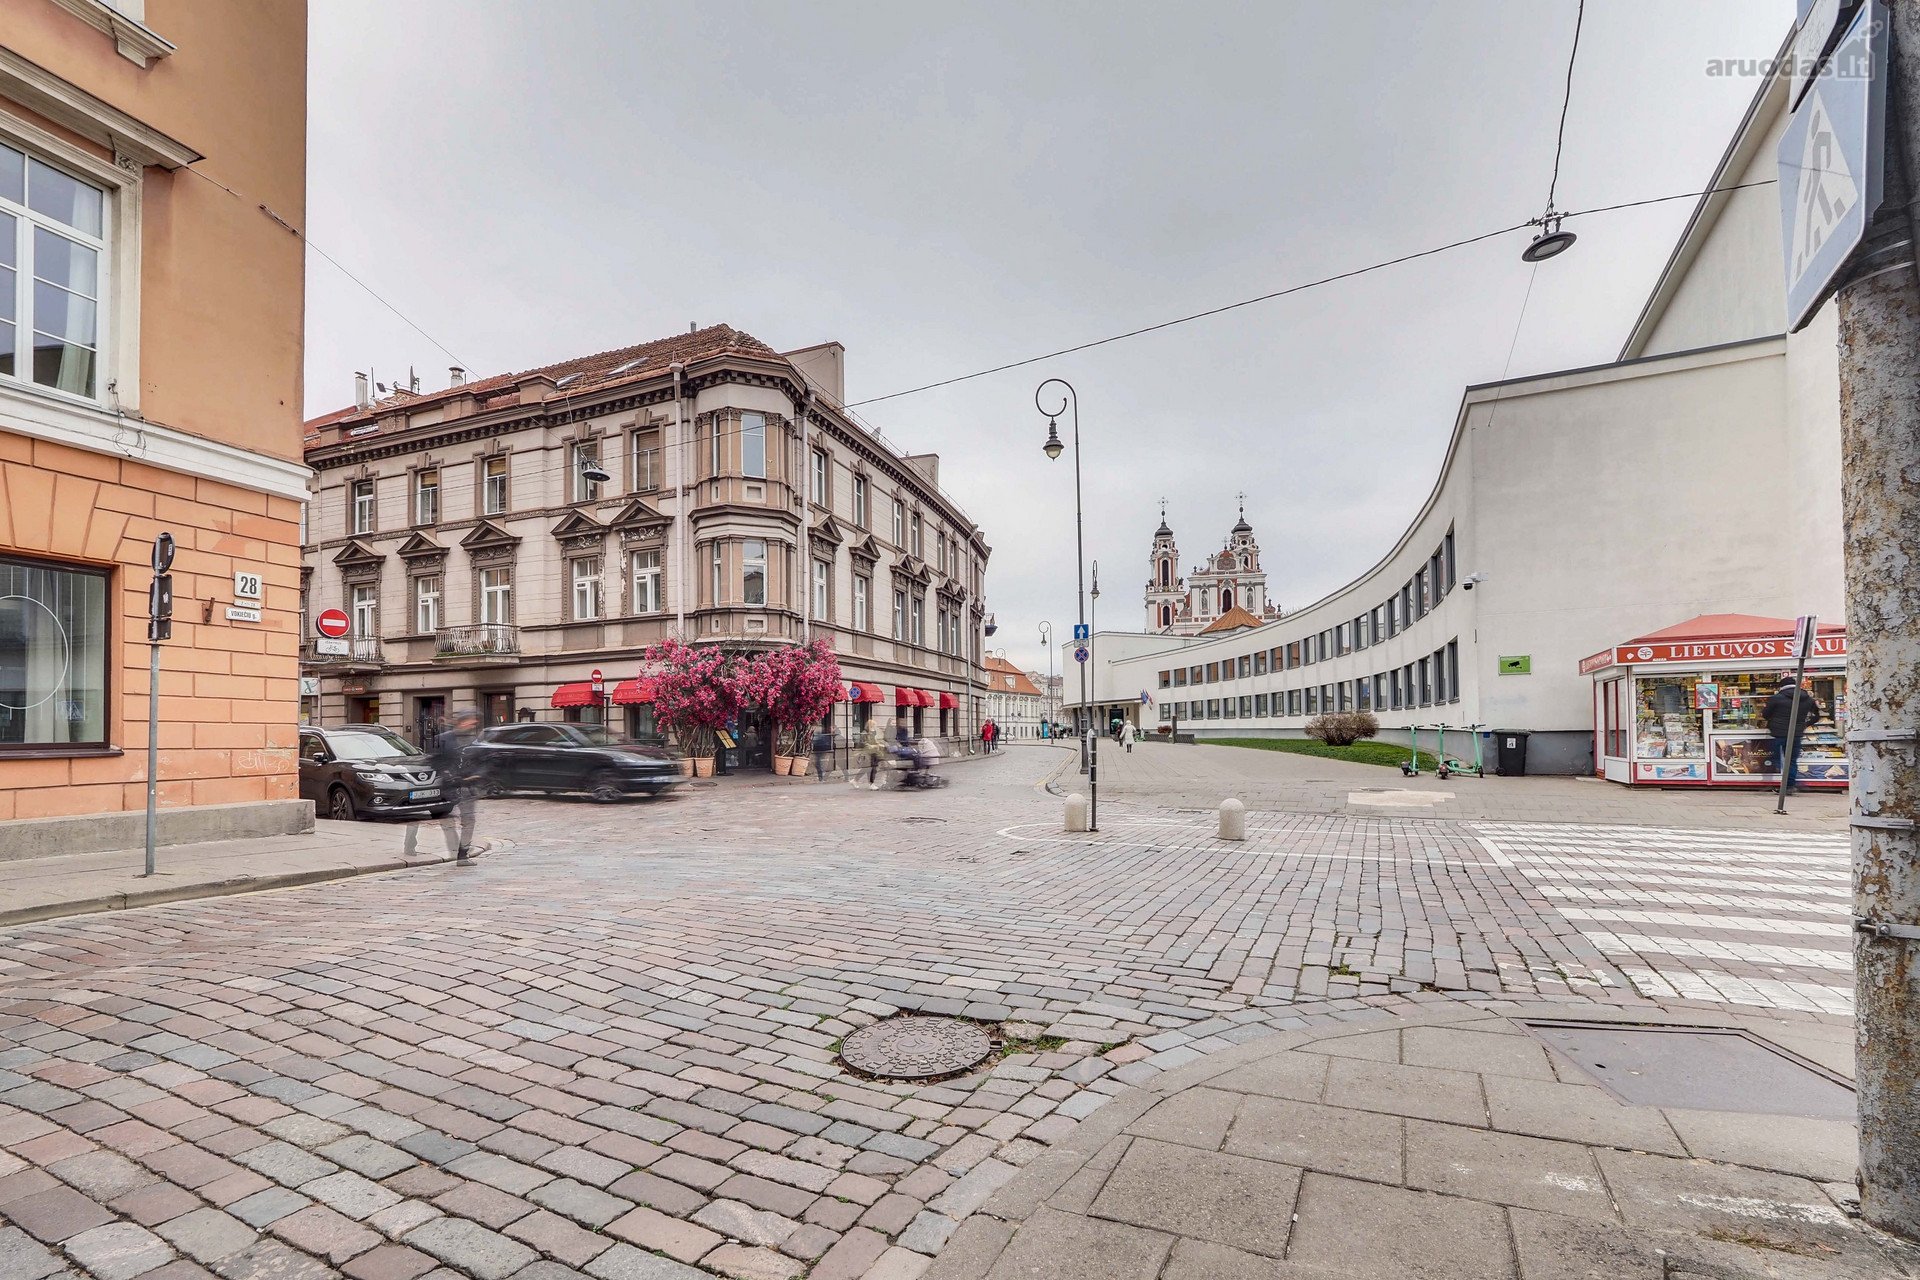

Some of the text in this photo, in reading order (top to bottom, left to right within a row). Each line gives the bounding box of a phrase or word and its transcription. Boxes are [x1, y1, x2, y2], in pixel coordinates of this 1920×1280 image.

[240, 576, 257, 595] 28
[1670, 641, 1776, 658] LIETUVOS
[1783, 638, 1847, 655] SAU
